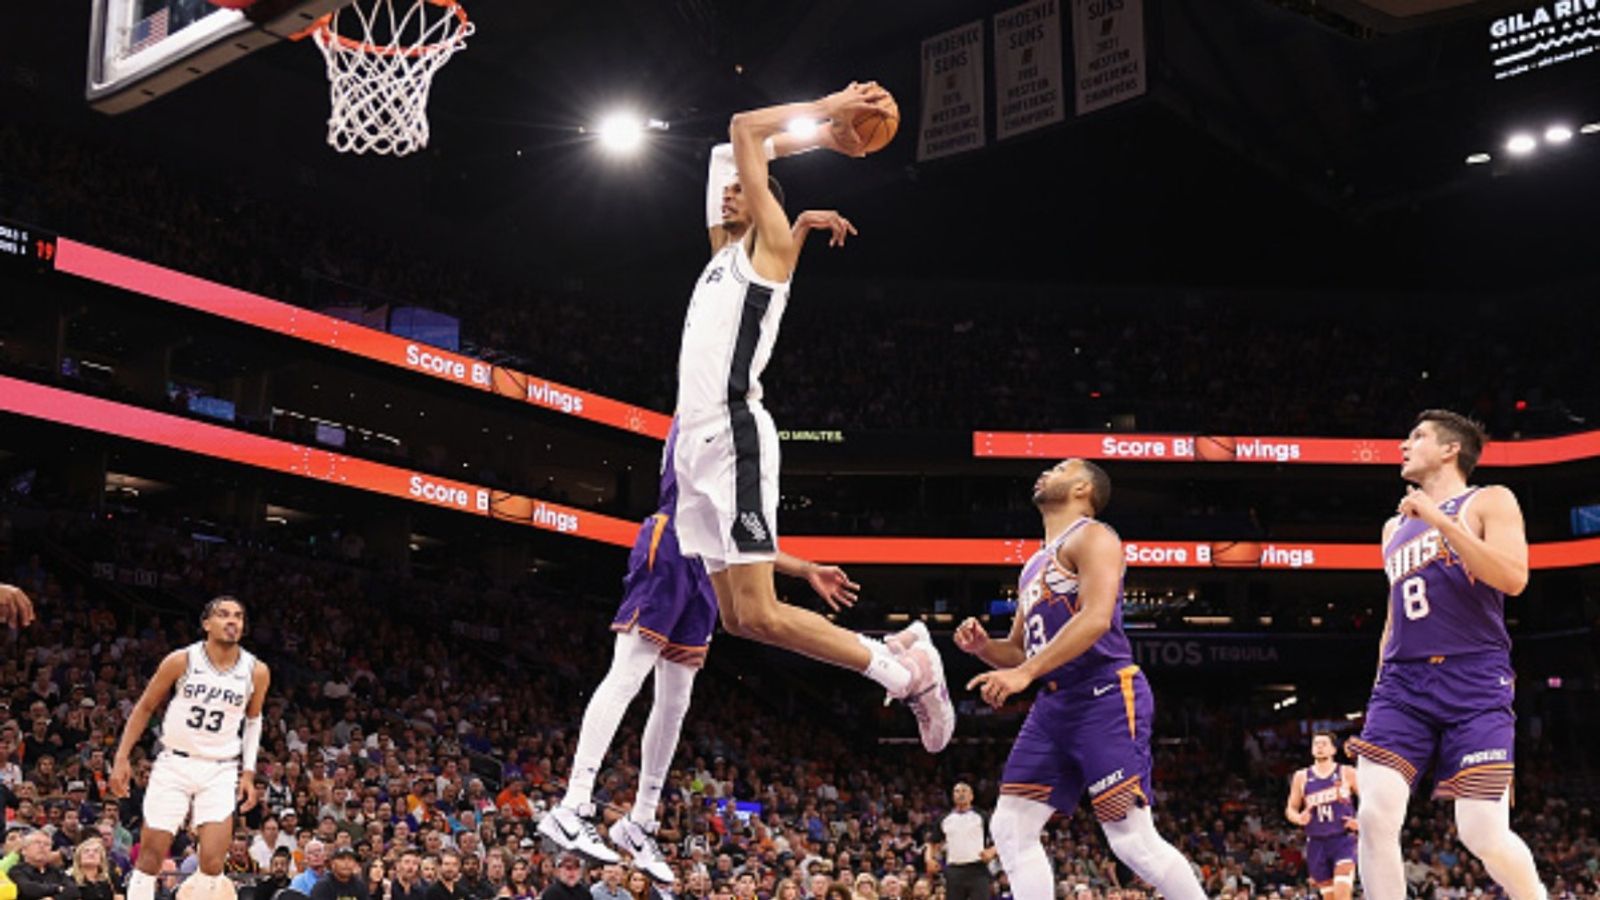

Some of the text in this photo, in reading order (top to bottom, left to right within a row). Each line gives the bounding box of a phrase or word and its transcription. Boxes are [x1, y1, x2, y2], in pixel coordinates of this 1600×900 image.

[1490, 7, 1551, 37] GILA
[1009, 24, 1044, 50] SUNS
[406, 345, 465, 378] Score
[528, 379, 583, 413] vings
[1102, 437, 1165, 456] Score
[1236, 439, 1300, 461] vings
[409, 476, 468, 505] Score
[1125, 544, 1187, 563] Score
[1402, 575, 1430, 620] 8
[1210, 645, 1279, 662] TEQUILA
[184, 684, 243, 706] SPURS
[186, 705, 225, 733] 33
[1317, 804, 1334, 823] 14
